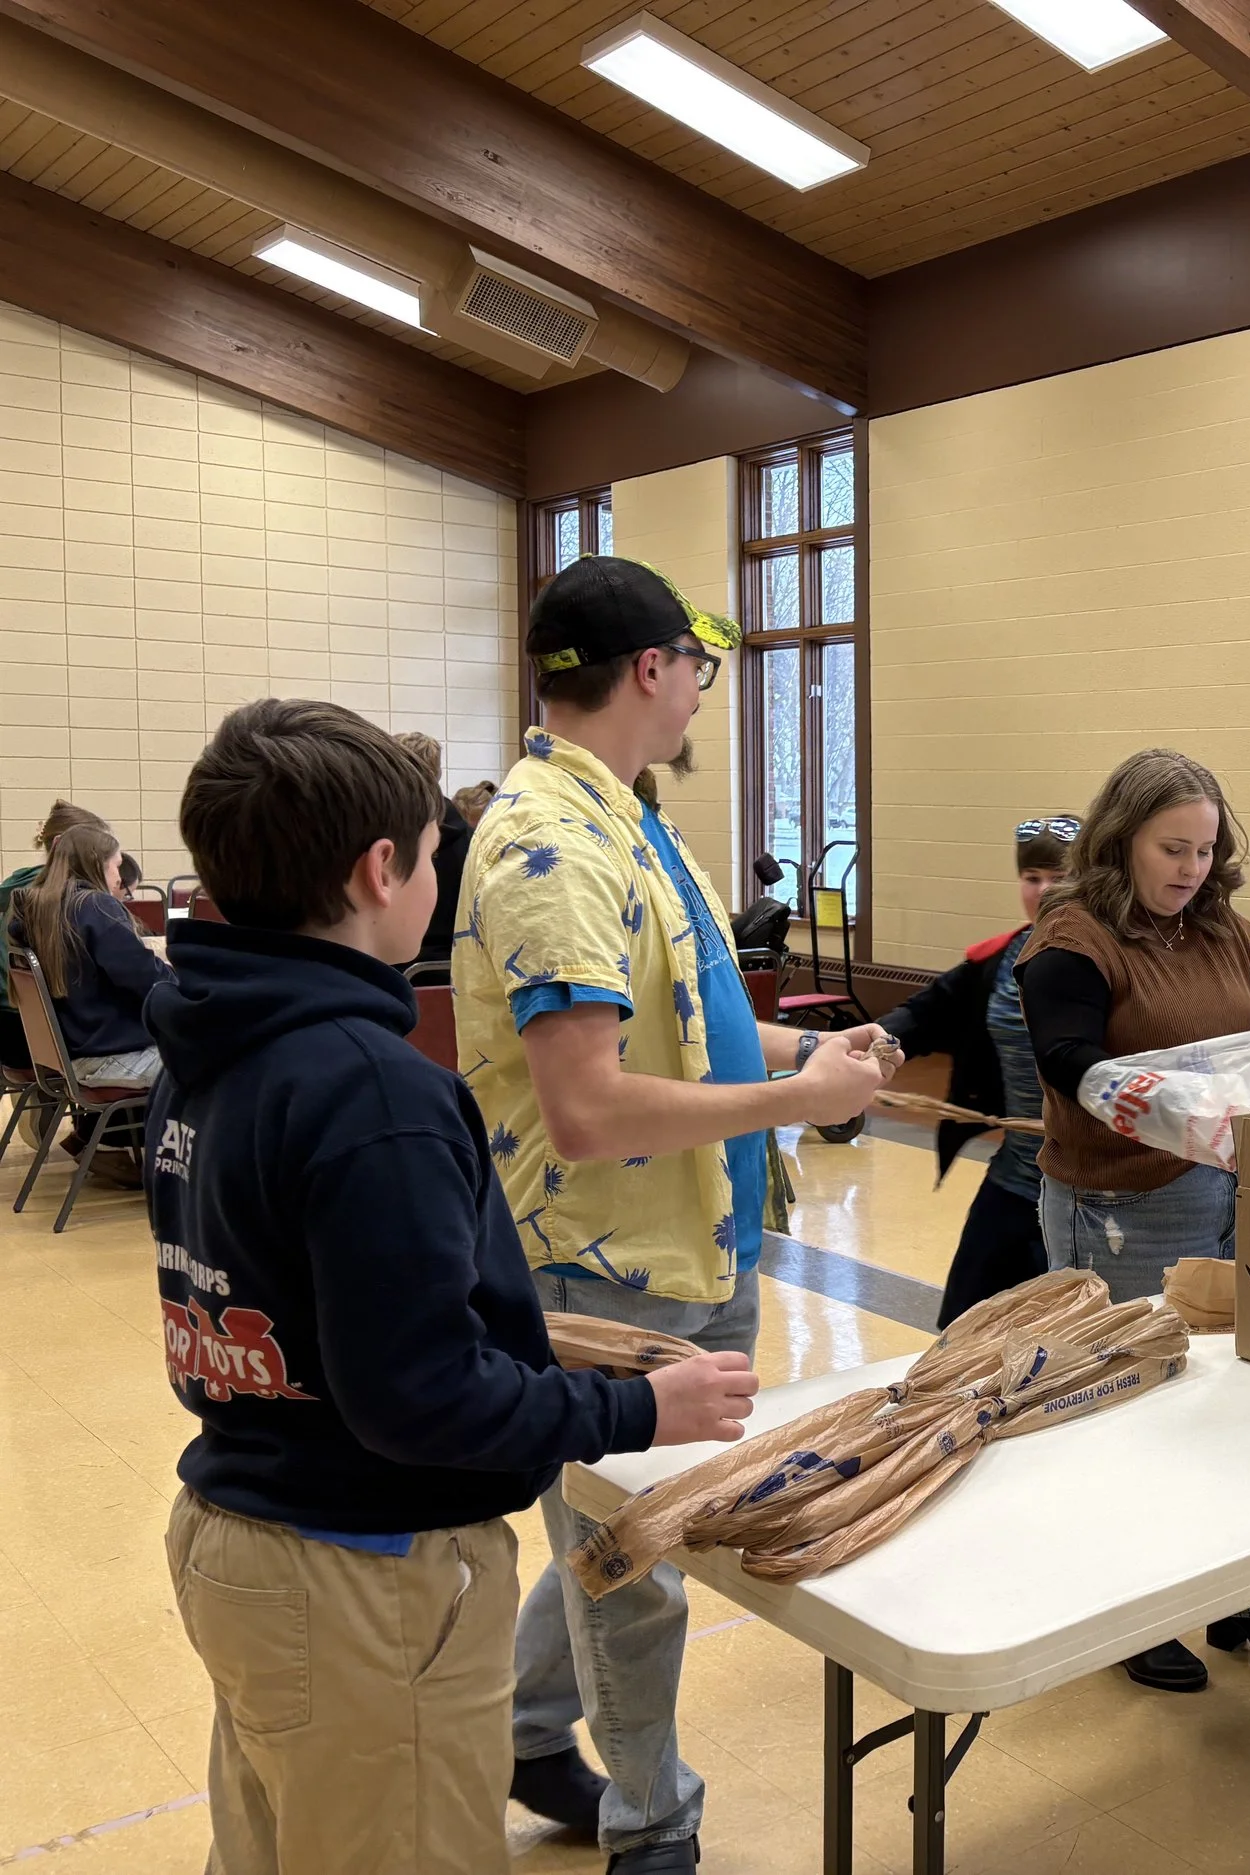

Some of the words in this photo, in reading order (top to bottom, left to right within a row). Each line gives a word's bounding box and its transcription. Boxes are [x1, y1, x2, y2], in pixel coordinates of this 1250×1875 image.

[163, 1313, 191, 1364] OR
[202, 1335, 272, 1386] TOTS
[1097, 1381, 1116, 1398] FOR
[1117, 1372, 1141, 1392] FRESH
